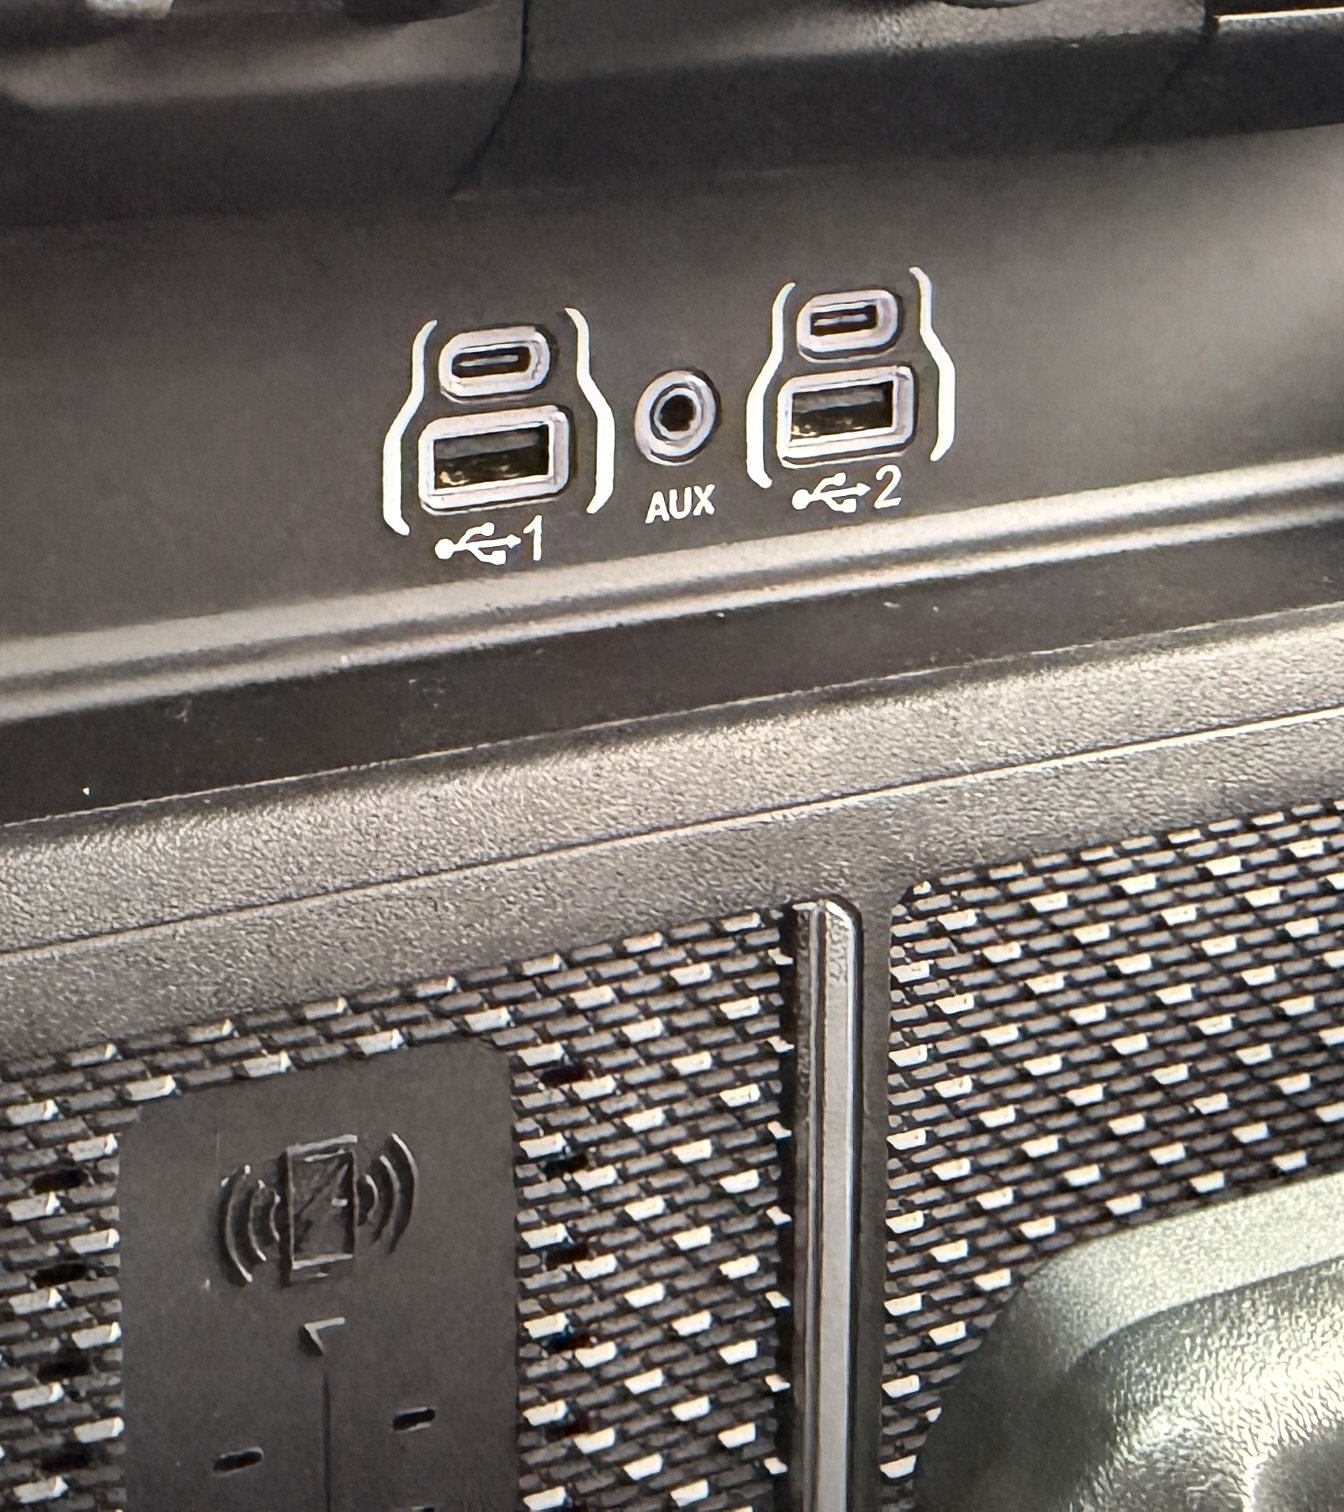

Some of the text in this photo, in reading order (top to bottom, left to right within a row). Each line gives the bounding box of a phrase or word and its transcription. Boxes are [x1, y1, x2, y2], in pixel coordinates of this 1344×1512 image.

[645, 484, 716, 525] AUX
[873, 464, 902, 509] 2
[524, 515, 543, 562] 1
